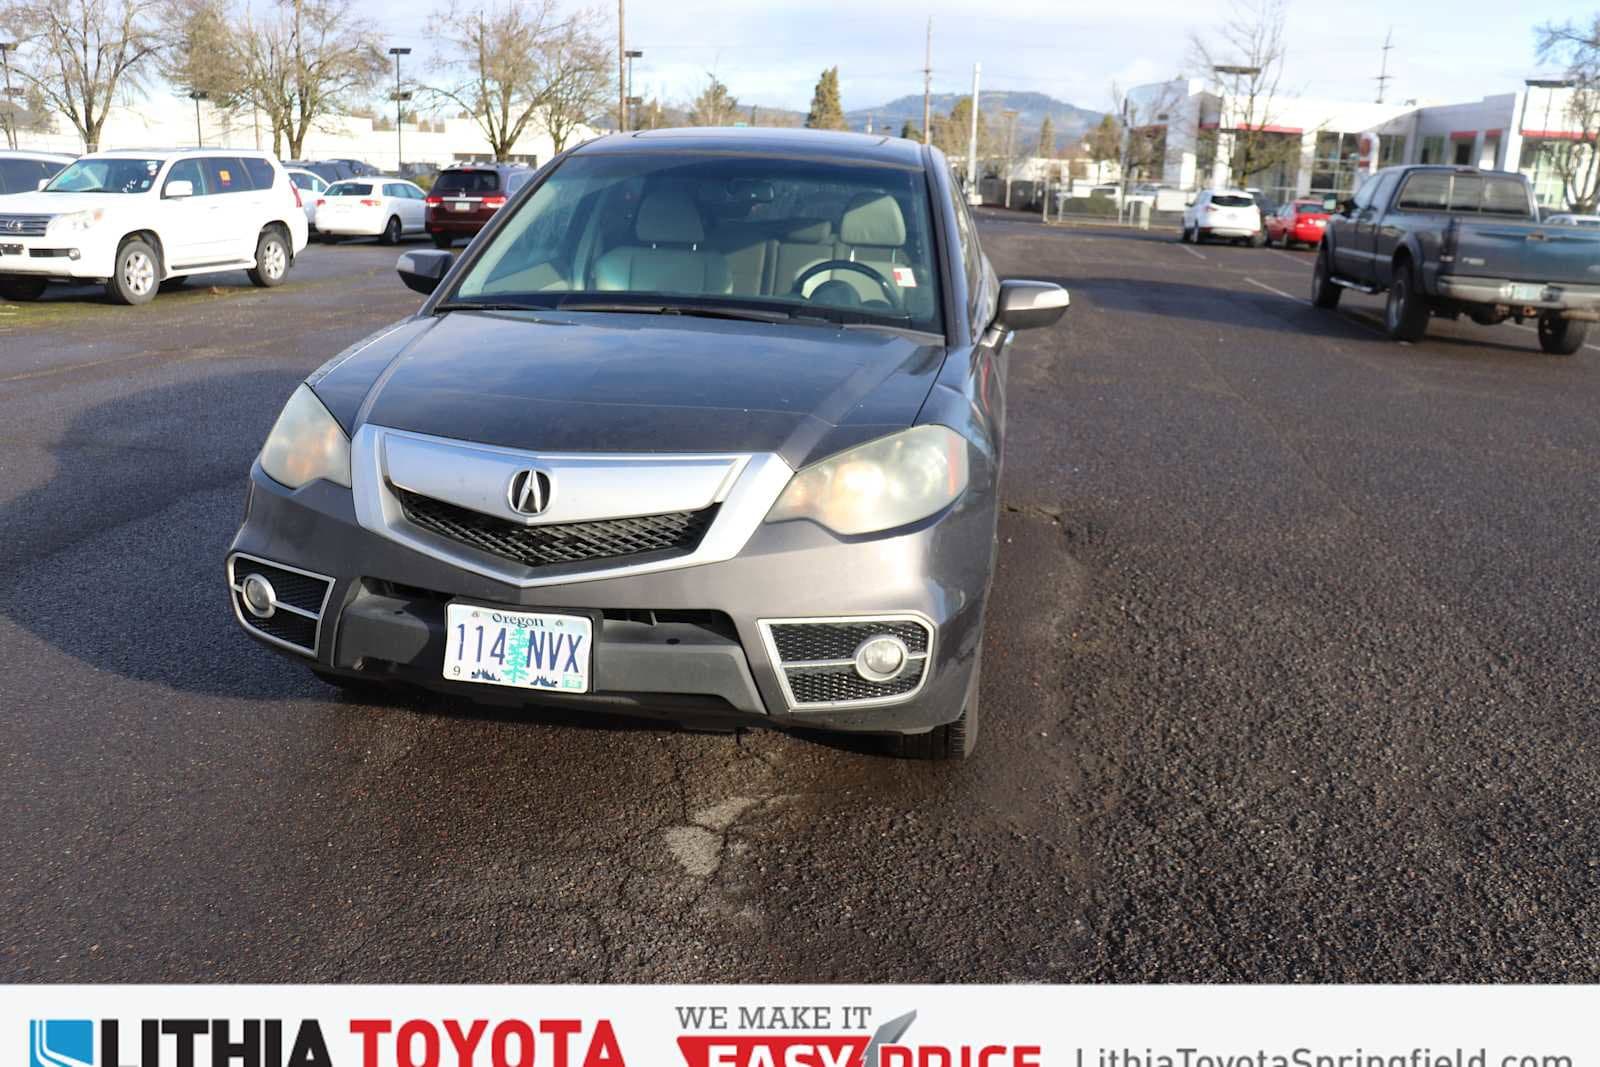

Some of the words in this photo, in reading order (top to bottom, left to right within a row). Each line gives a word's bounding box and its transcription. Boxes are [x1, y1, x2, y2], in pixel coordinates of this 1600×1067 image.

[491, 612, 544, 628] Oregon
[457, 623, 507, 665] 114
[525, 630, 583, 673] NVX
